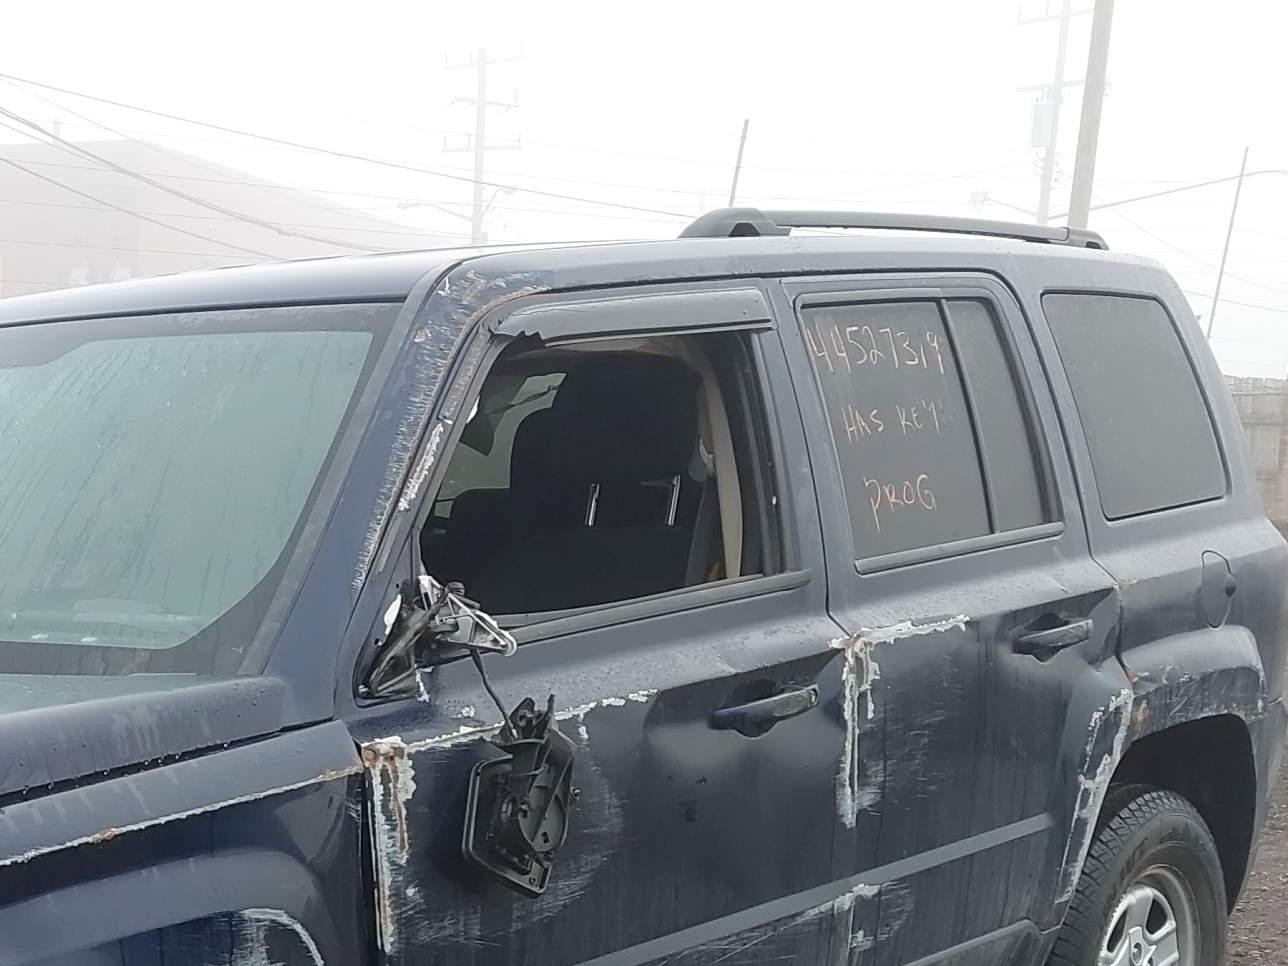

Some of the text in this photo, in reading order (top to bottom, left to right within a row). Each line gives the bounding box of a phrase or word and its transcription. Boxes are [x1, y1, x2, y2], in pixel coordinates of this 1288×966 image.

[807, 321, 945, 375] 44527319
[842, 399, 940, 443] HAS KEY
[863, 473, 937, 533] PROG
